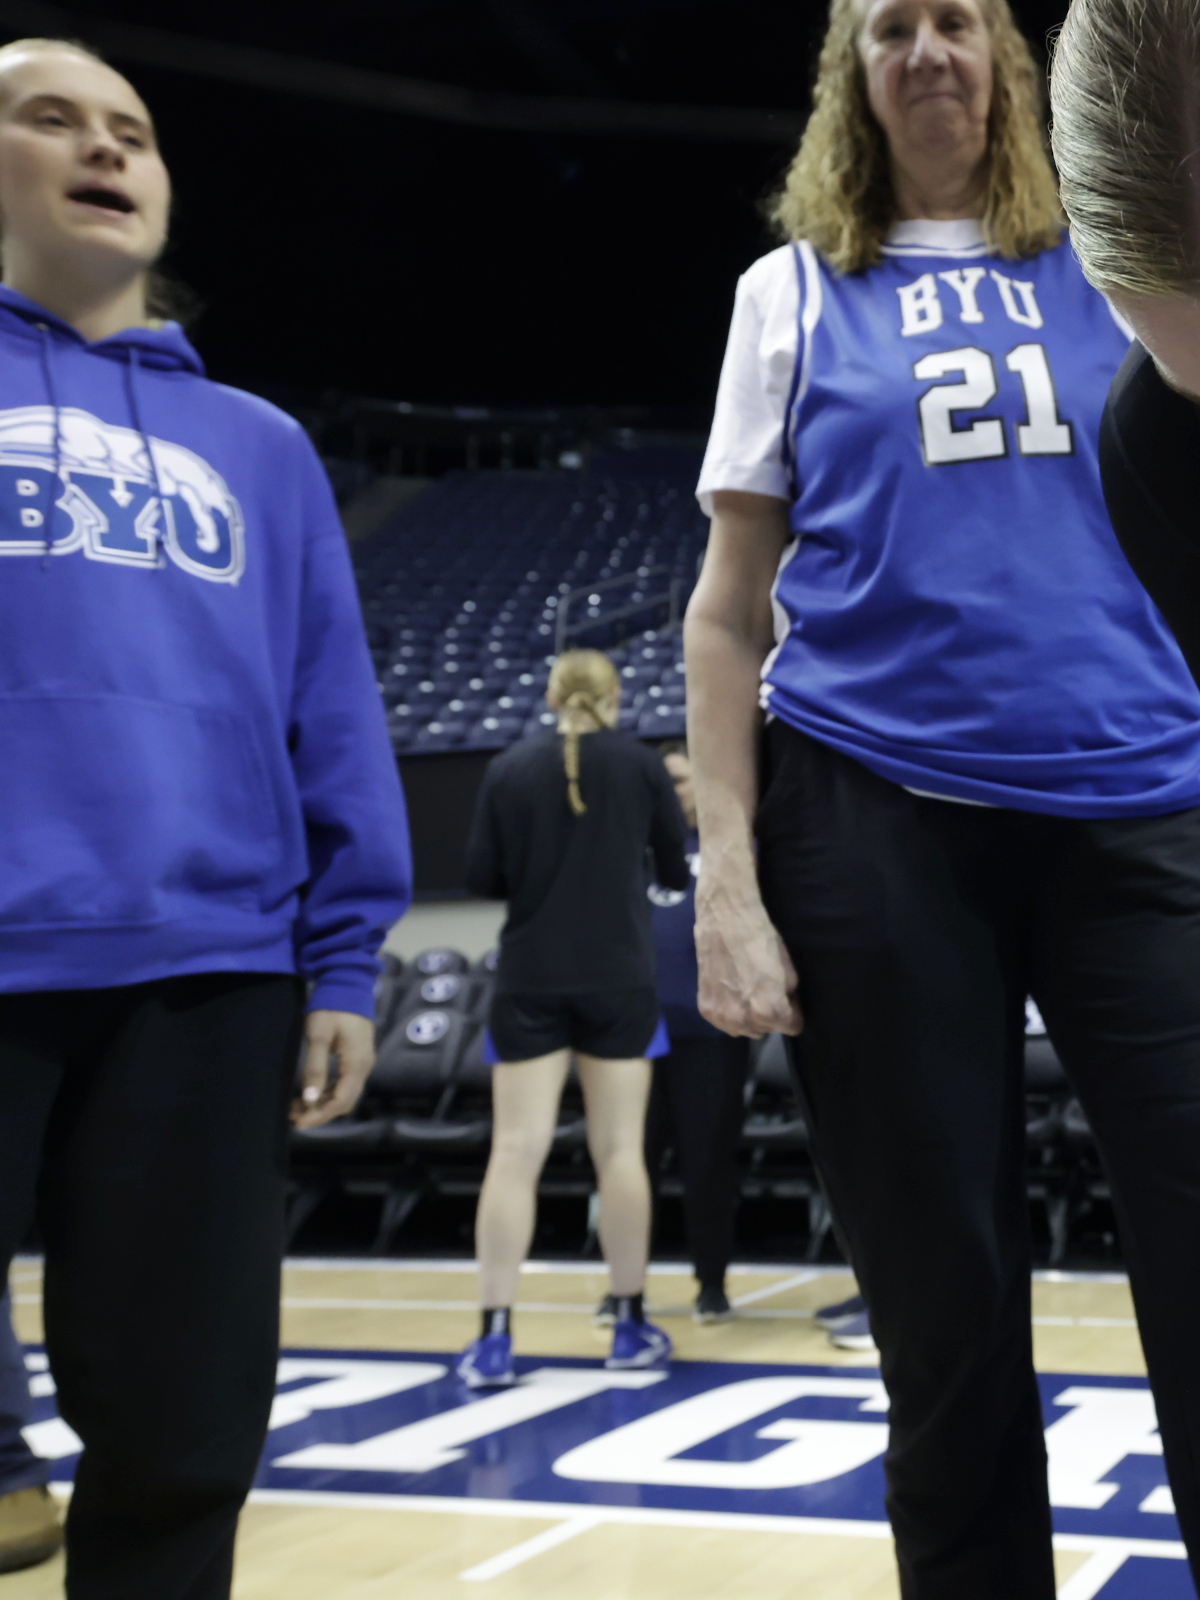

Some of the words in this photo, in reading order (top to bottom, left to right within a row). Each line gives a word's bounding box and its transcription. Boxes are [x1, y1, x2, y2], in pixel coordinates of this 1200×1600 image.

[897, 267, 1043, 337] BYU
[913, 343, 1075, 467] 21
[0, 460, 246, 586] BYU
